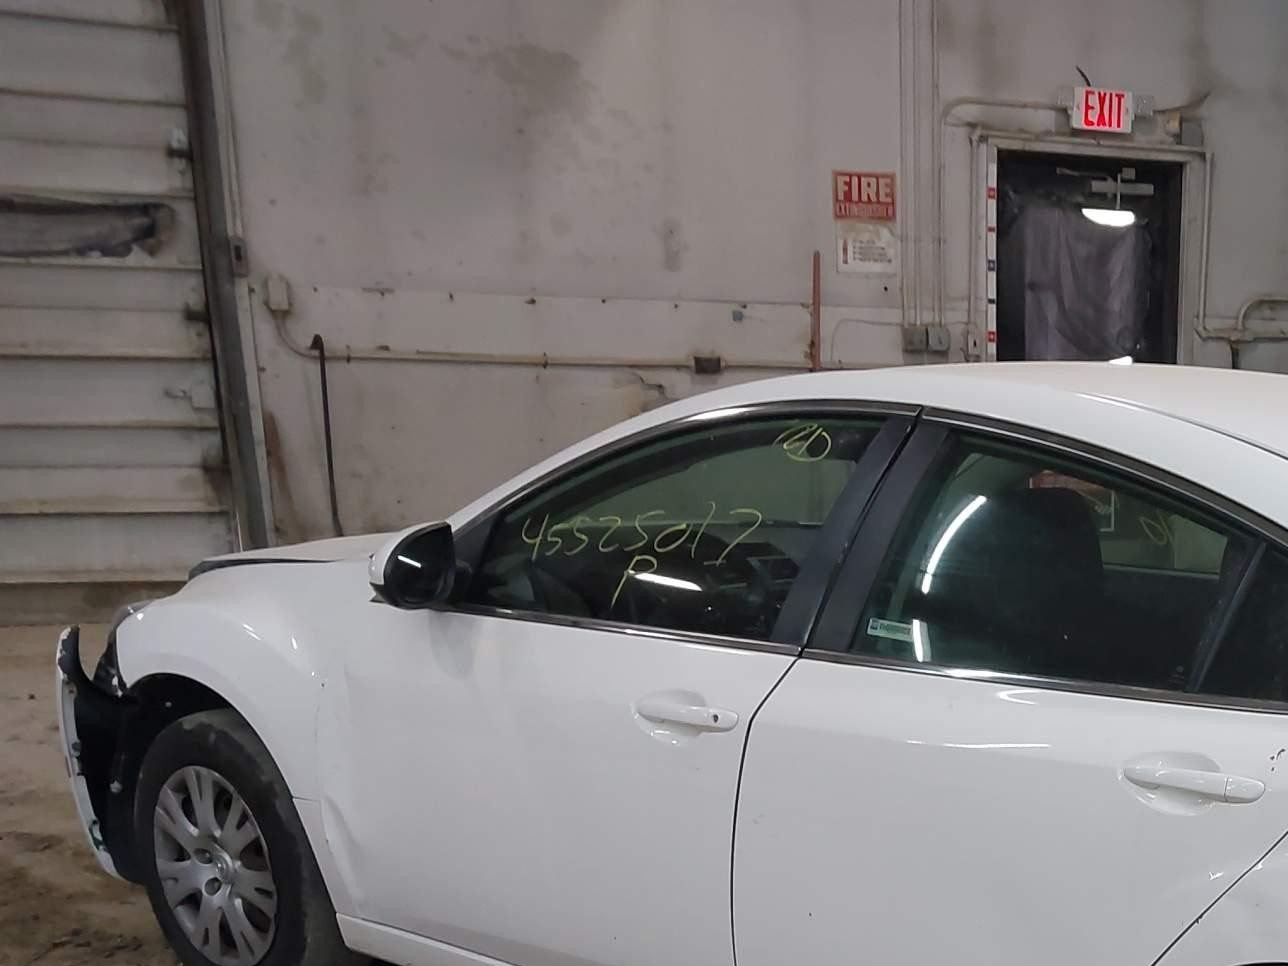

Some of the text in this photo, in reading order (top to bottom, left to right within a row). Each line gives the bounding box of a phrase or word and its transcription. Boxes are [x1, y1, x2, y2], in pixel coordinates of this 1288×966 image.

[1083, 89, 1125, 129] EXIT
[836, 175, 893, 203] FIRE
[521, 501, 763, 567] 45525017
